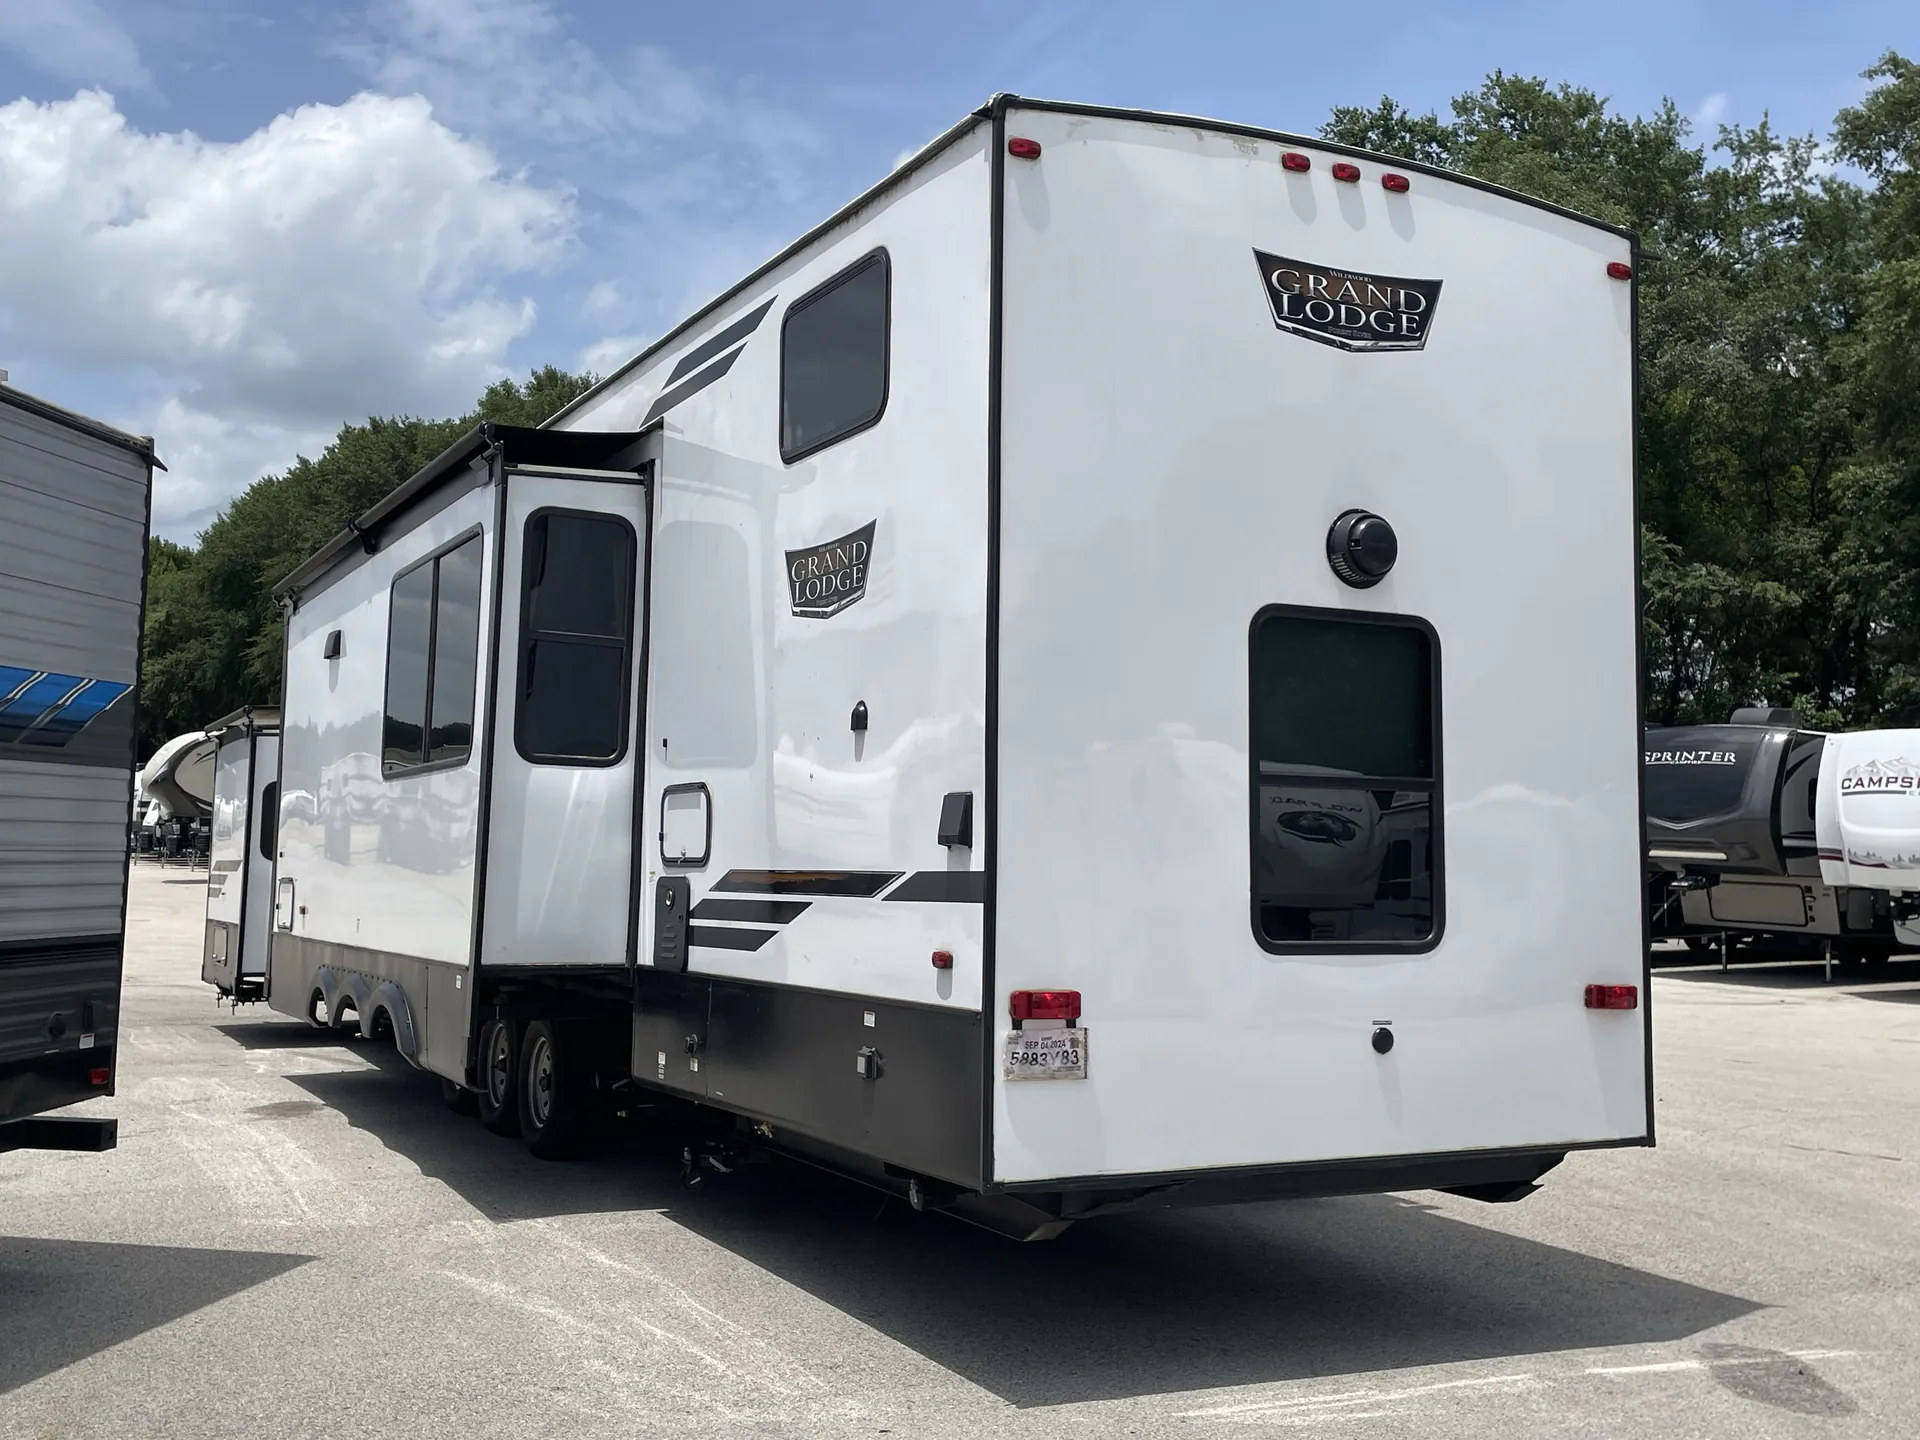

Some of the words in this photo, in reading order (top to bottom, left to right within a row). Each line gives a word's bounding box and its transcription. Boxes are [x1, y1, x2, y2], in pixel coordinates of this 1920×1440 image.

[1271, 268, 1427, 313] GRAND
[1279, 293, 1421, 337] LODGE
[791, 540, 868, 582] GRAND
[794, 564, 864, 604] LODGE
[1645, 751, 1736, 762] SPRINTER
[1009, 1049, 1080, 1067] 5883Y83
[1024, 1040, 1039, 1050] SEP
